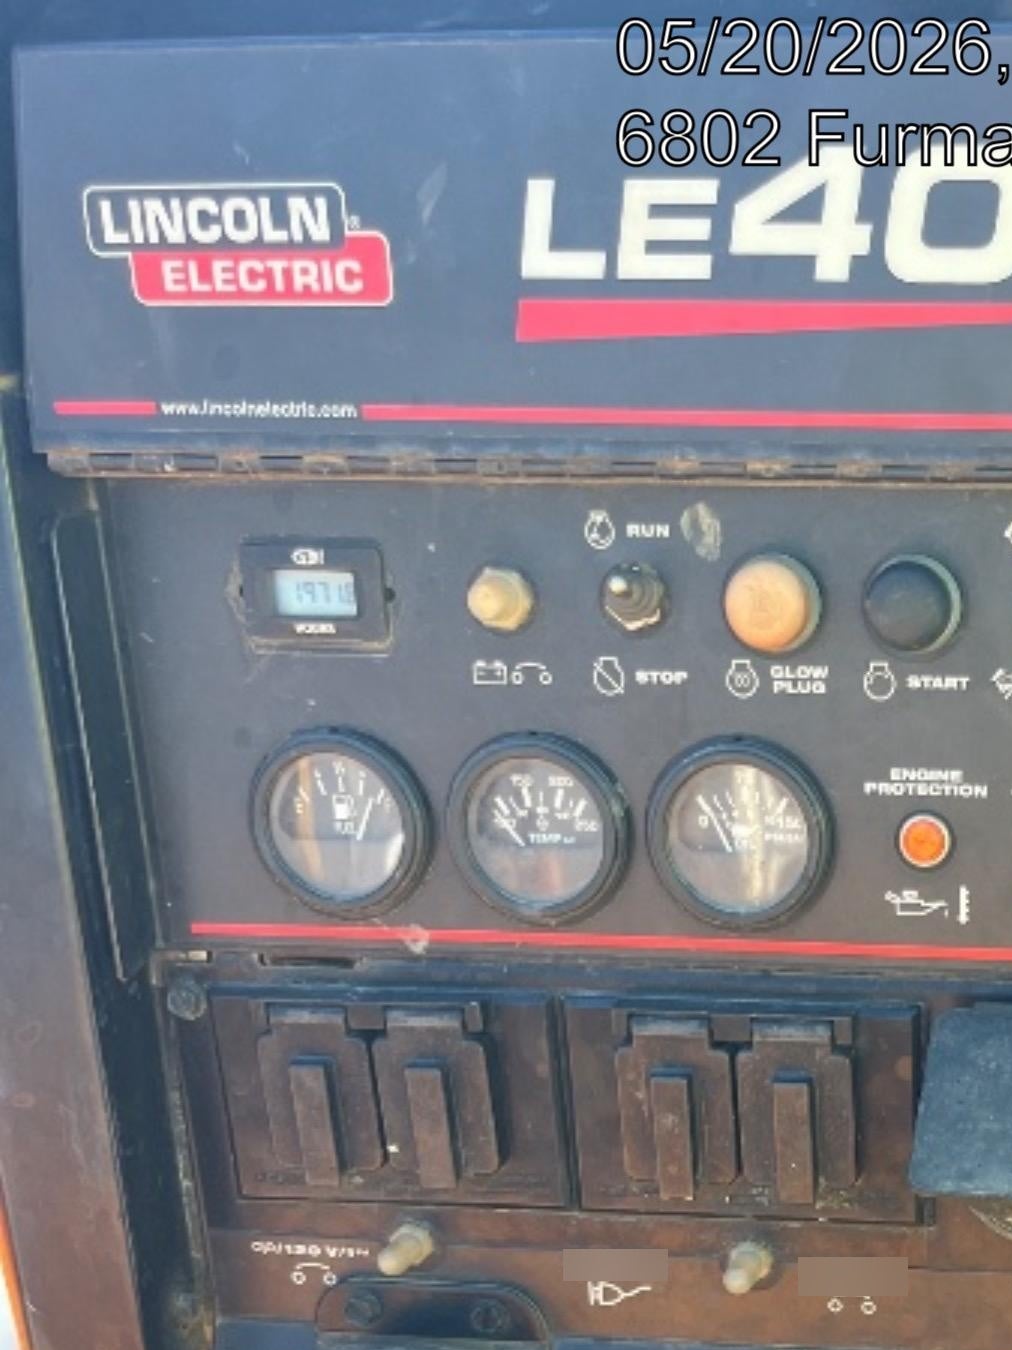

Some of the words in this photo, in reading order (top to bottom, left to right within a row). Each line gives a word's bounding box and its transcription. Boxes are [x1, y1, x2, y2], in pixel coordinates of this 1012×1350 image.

[99, 196, 331, 244] LINCOLN
[161, 259, 365, 294] ELECTRIC
[160, 397, 359, 420] www.lincolnelectric.com
[626, 523, 670, 538] RUN
[635, 670, 688, 685] STOP
[770, 665, 829, 679] GLOW
[773, 679, 826, 694] PLUG
[906, 676, 970, 691] START
[889, 768, 963, 783] ENGINE
[863, 782, 988, 799] PROTECTION
